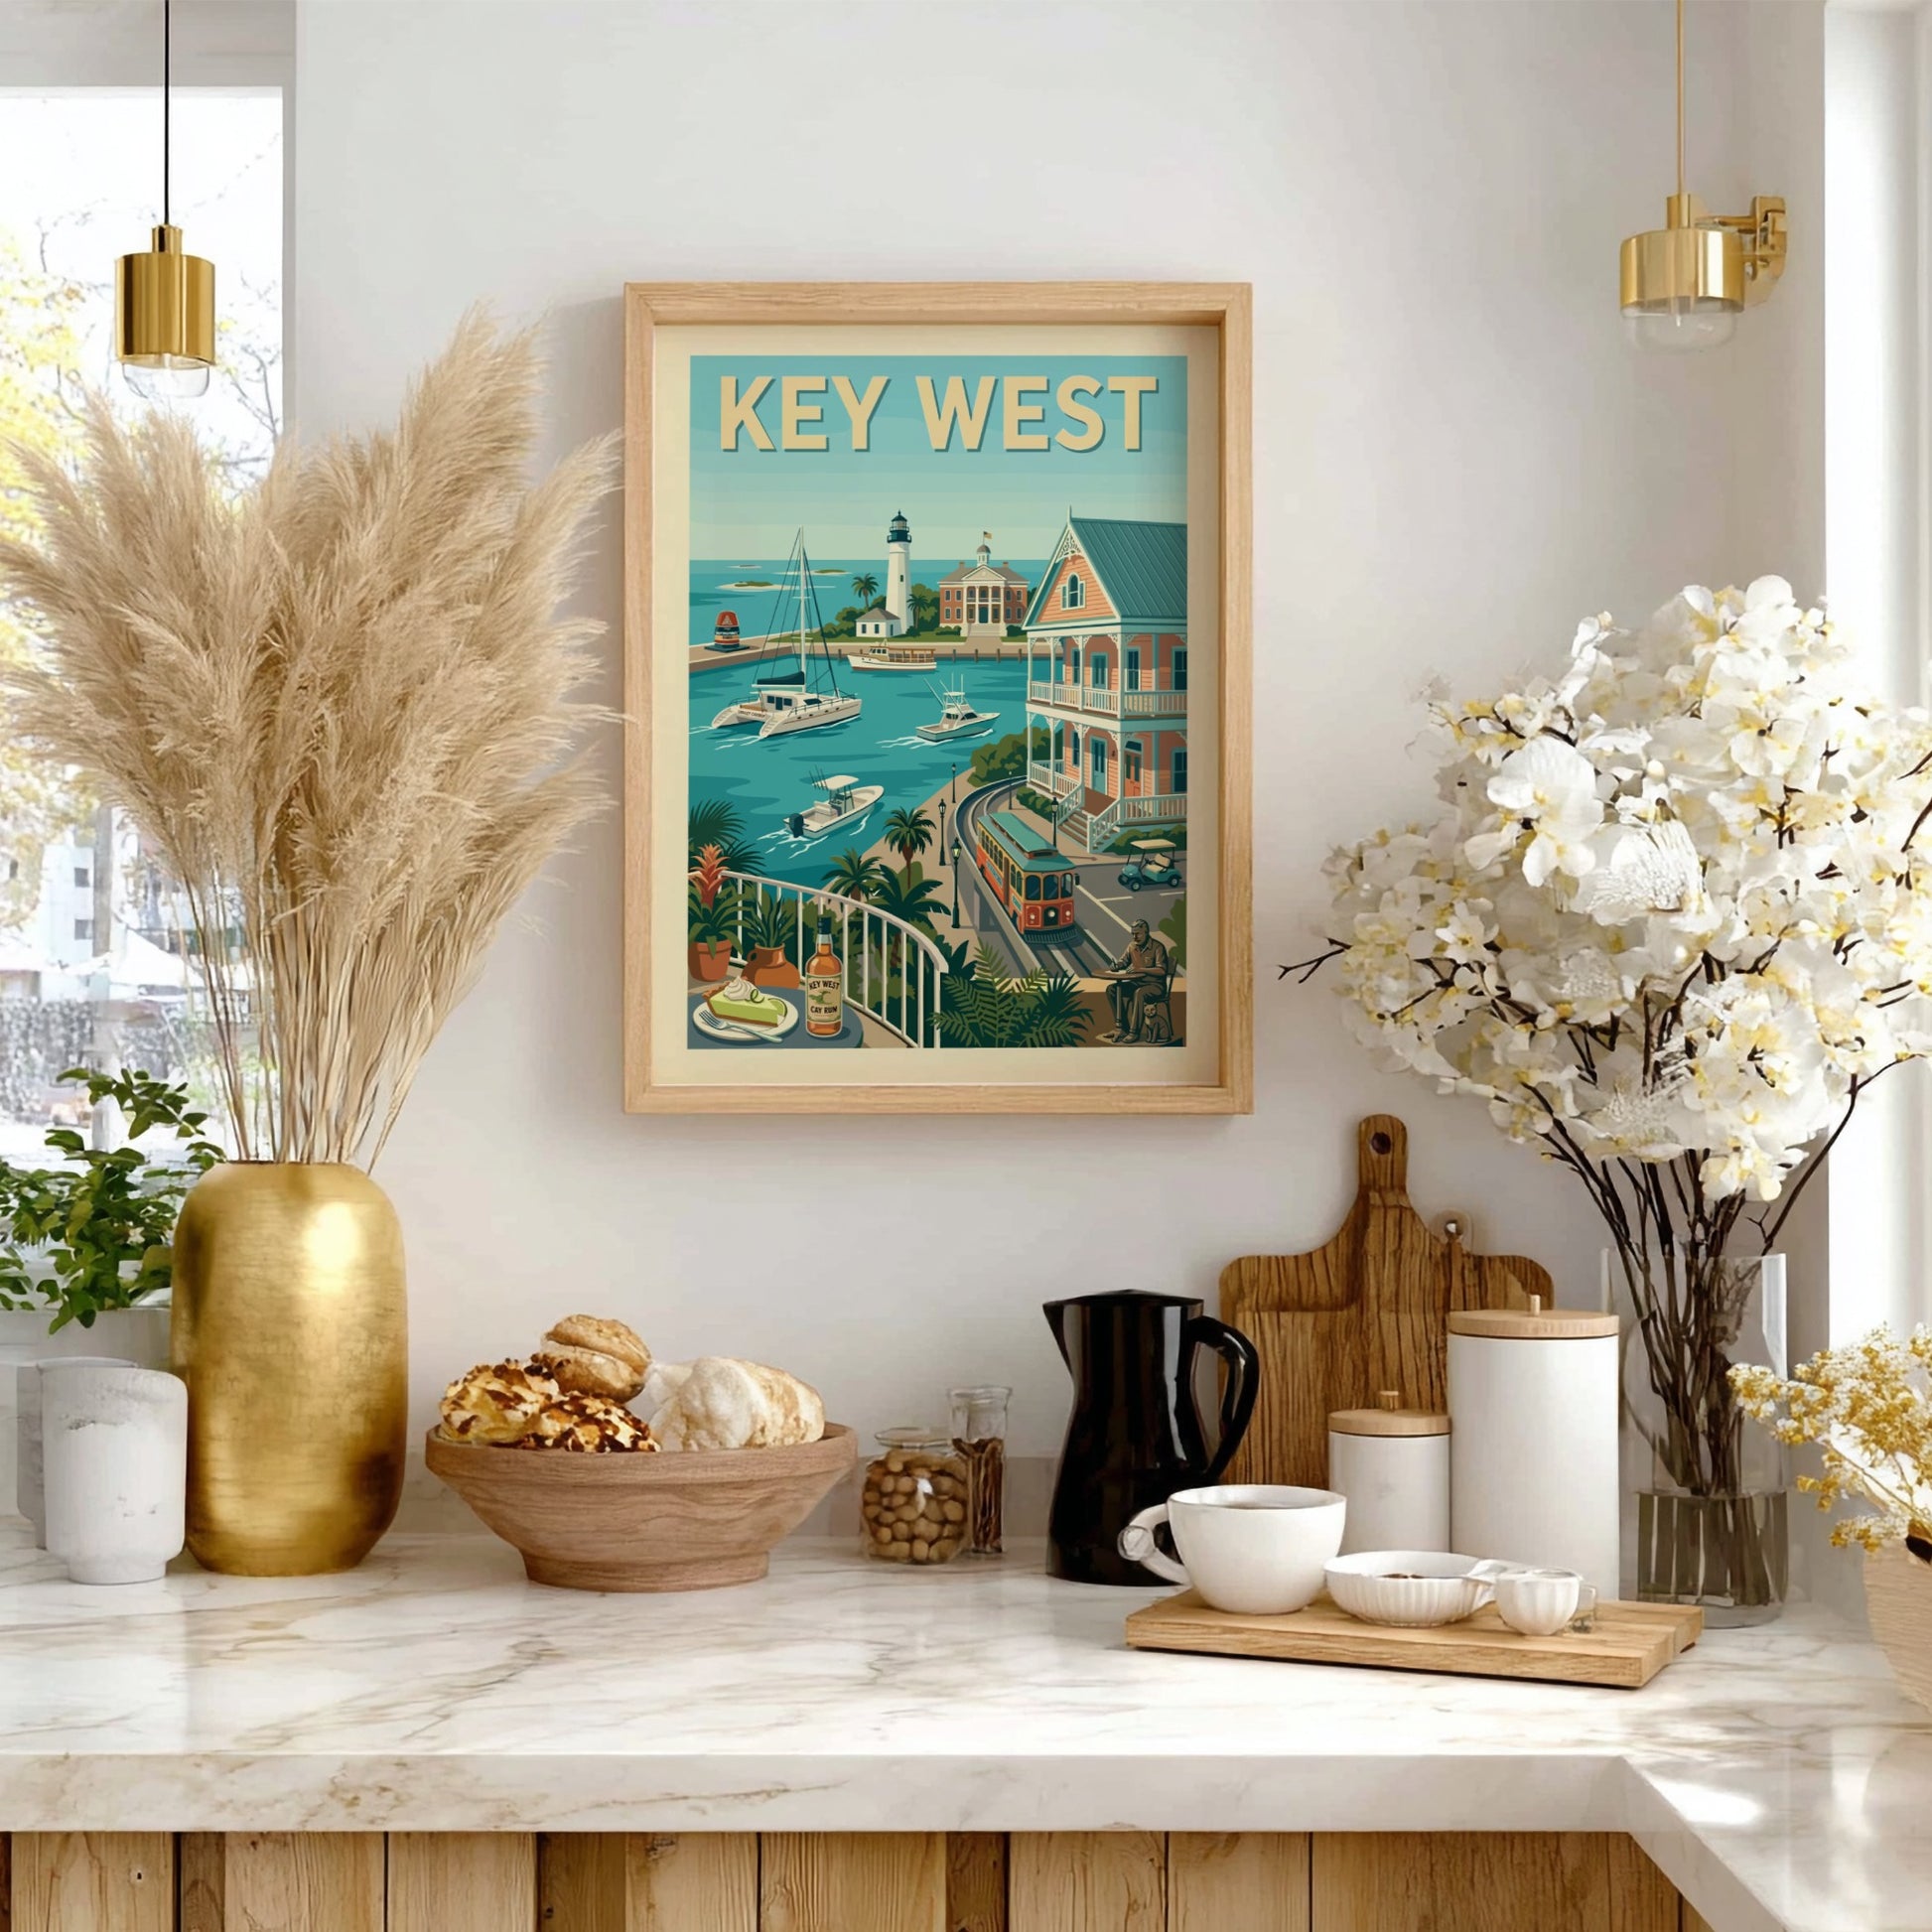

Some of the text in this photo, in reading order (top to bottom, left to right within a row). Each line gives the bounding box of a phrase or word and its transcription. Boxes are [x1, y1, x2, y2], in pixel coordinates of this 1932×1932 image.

[720, 374, 1159, 453] KEY WEST
[809, 980, 840, 990] KEY WEST
